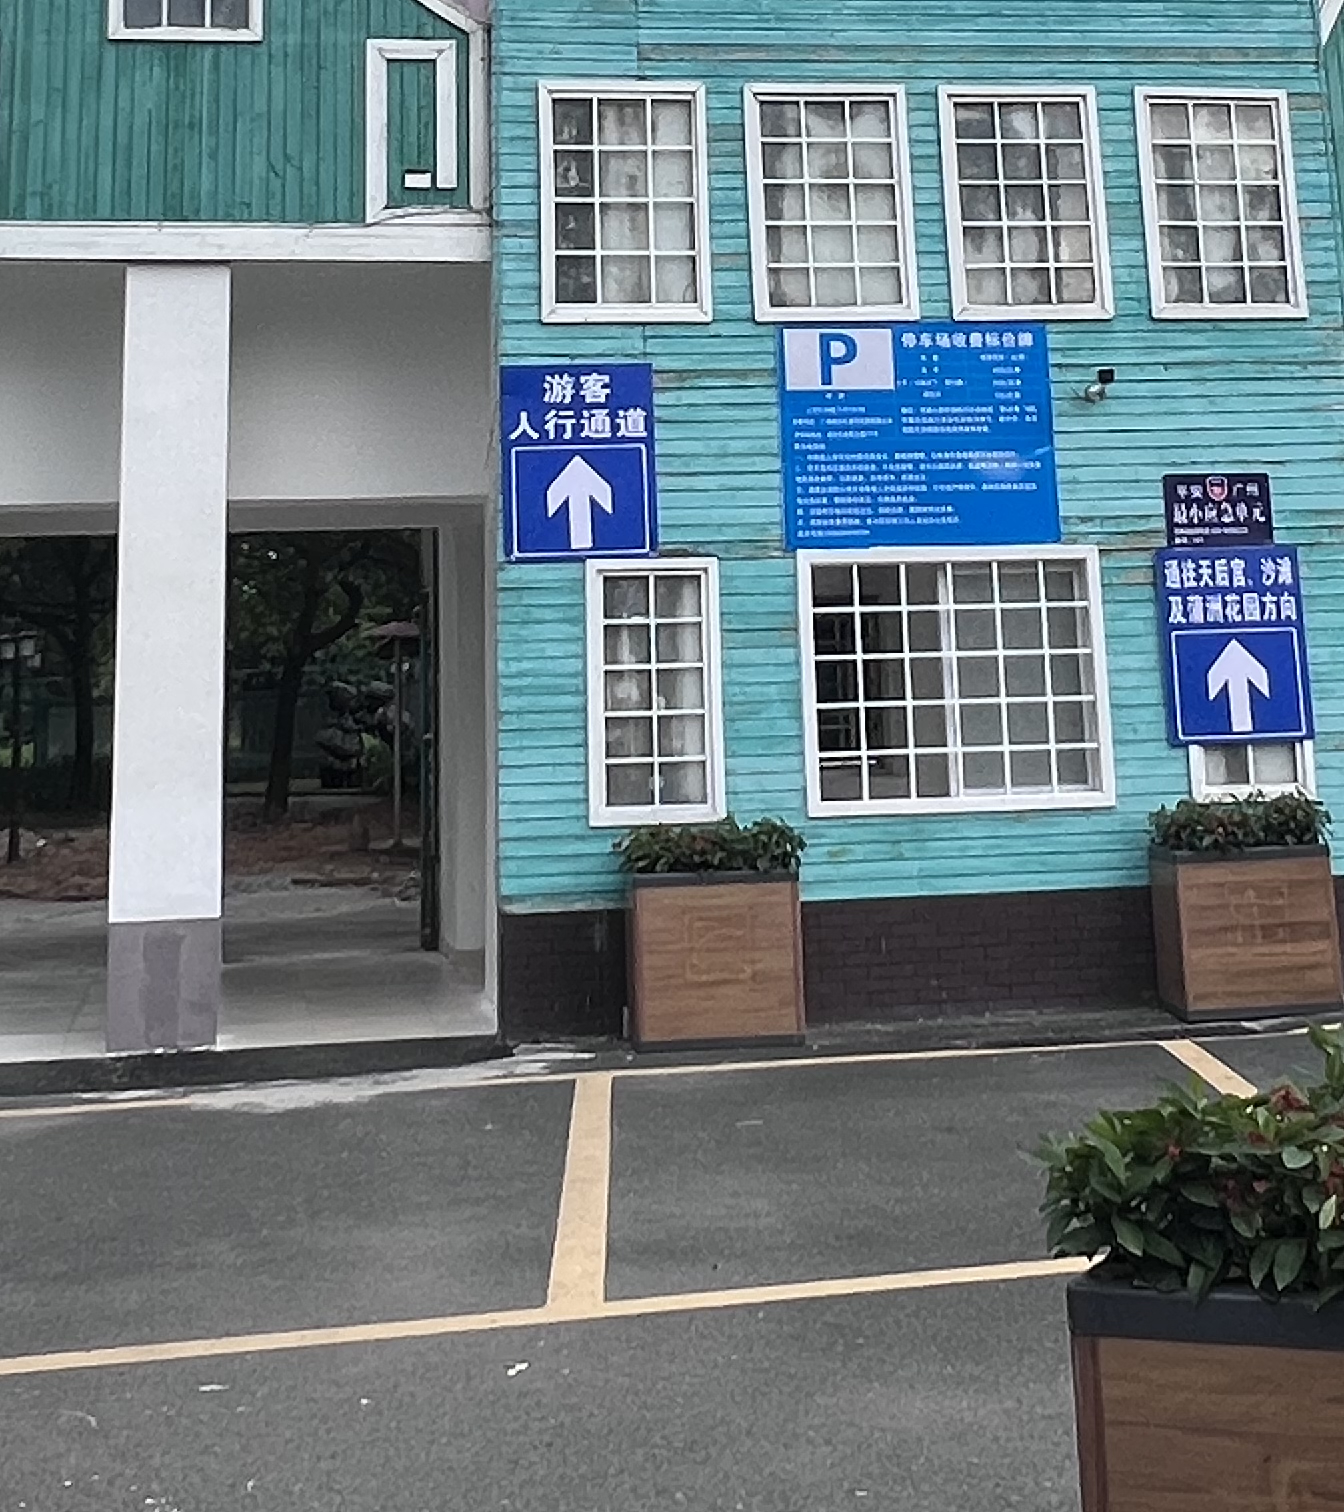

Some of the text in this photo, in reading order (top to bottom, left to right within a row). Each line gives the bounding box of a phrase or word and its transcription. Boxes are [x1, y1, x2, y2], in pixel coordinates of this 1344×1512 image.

[819, 333, 857, 386] P
[543, 372, 611, 404] 游客
[509, 406, 648, 440] 人行通道
[1173, 501, 1266, 524] 最小应急单元
[1168, 591, 1298, 624] 及蒲洲花园方向
